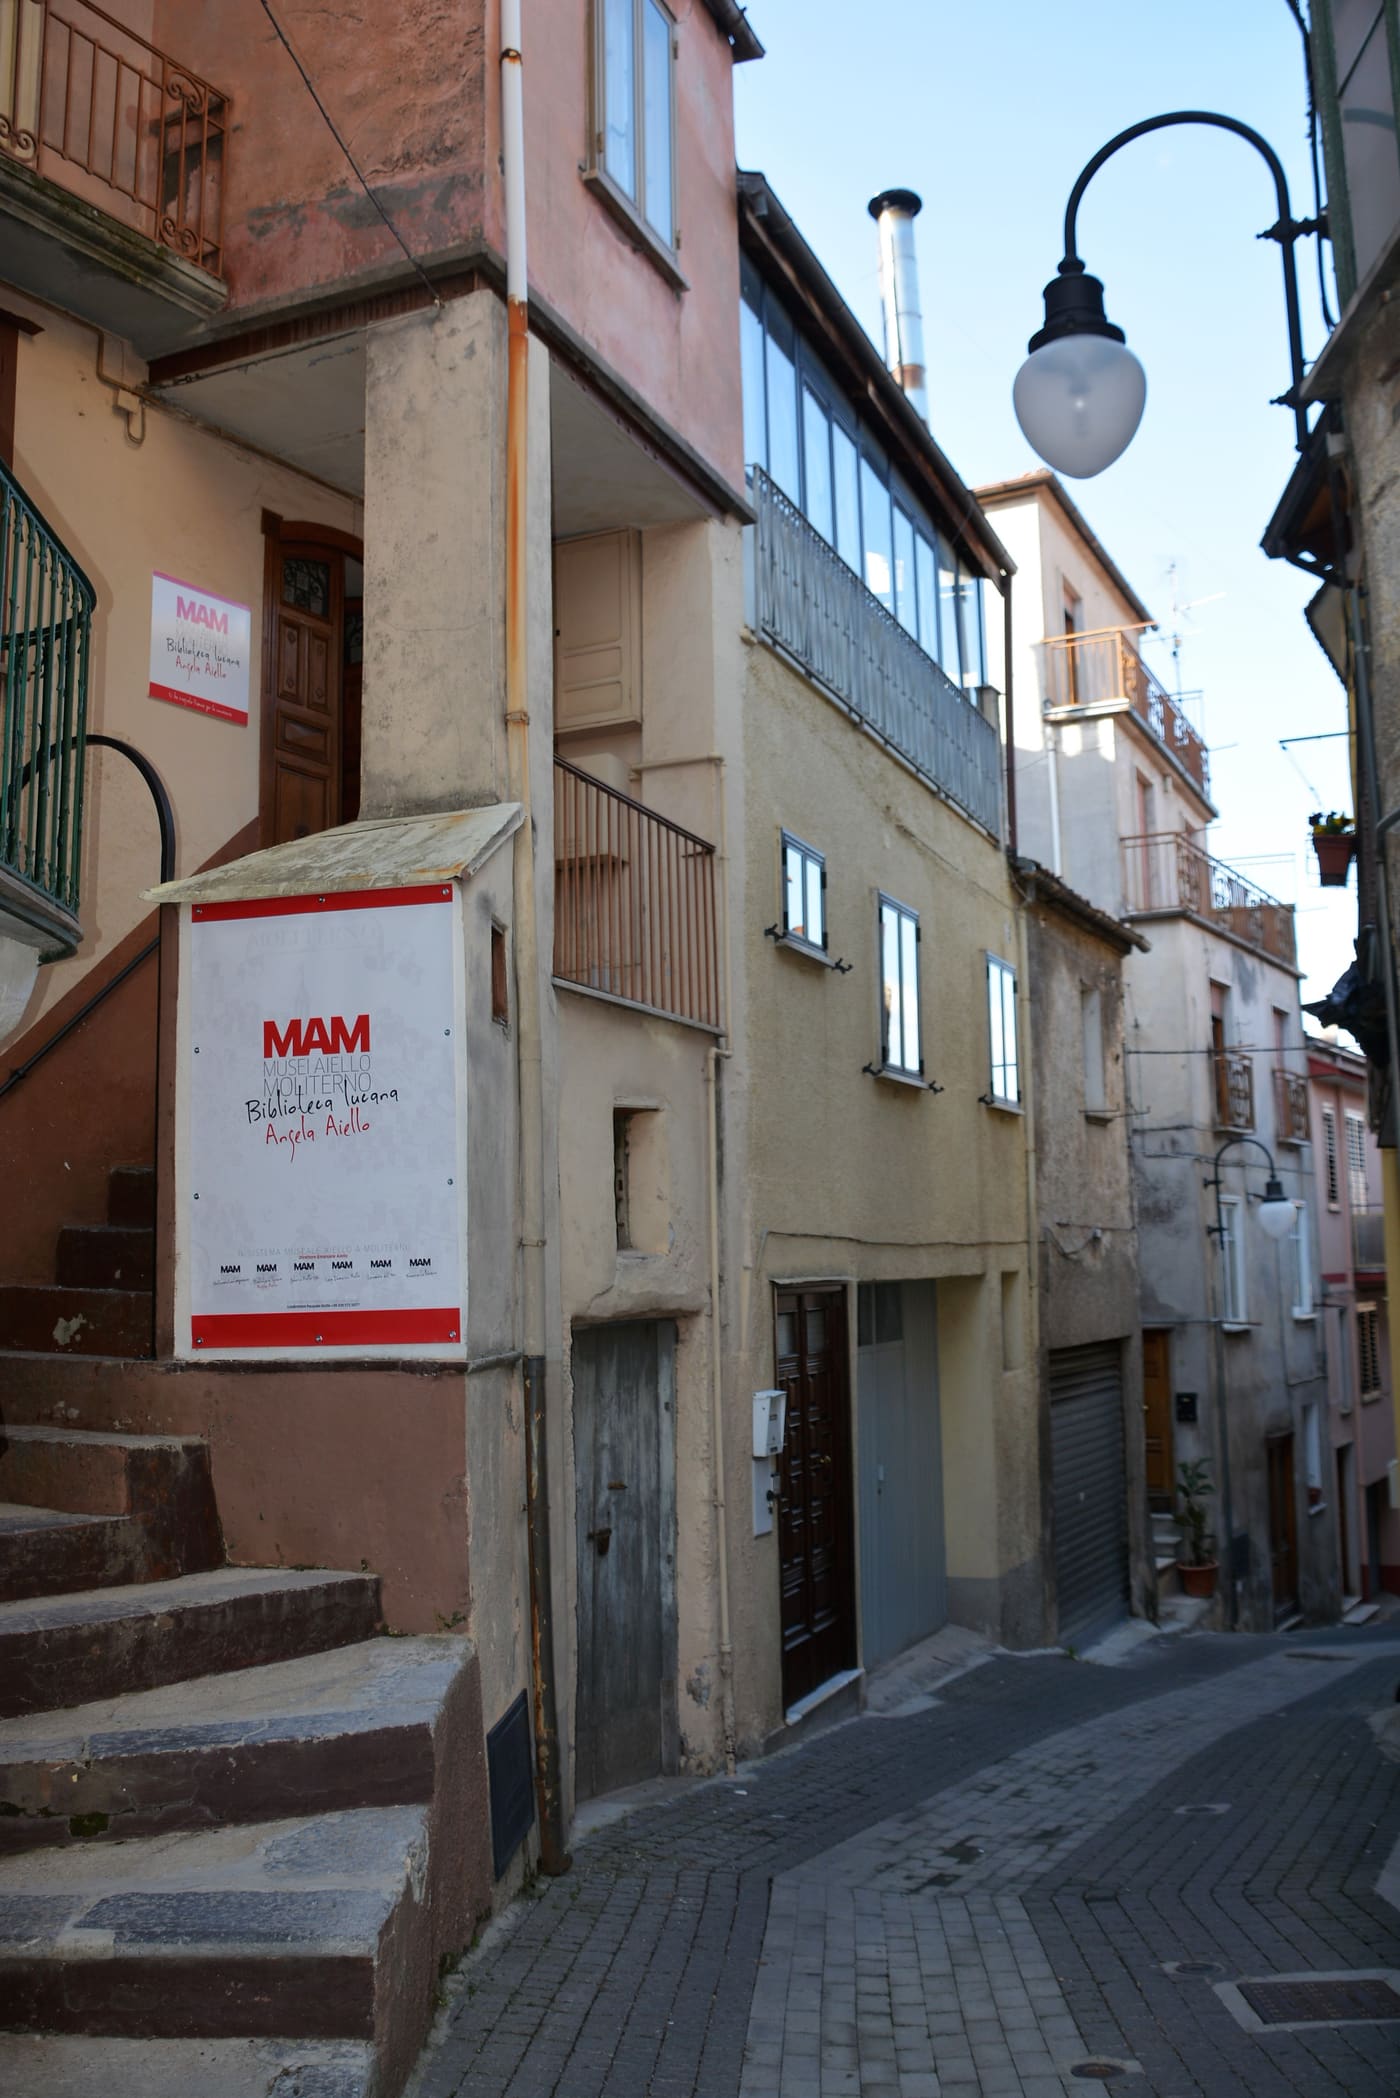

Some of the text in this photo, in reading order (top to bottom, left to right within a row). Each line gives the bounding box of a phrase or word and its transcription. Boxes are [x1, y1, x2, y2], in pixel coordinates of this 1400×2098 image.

[176, 595, 229, 634] MAM
[263, 1014, 370, 1058] MAM
[263, 1054, 371, 1077] MUSEI AIELLO
[263, 1072, 372, 1097] MOLITERNO
[245, 1085, 333, 1124] Biblioteca
[266, 1107, 370, 1163] Angela Aiello
[220, 1258, 431, 1273] MAM MAM MAM MAM MAM MAM
